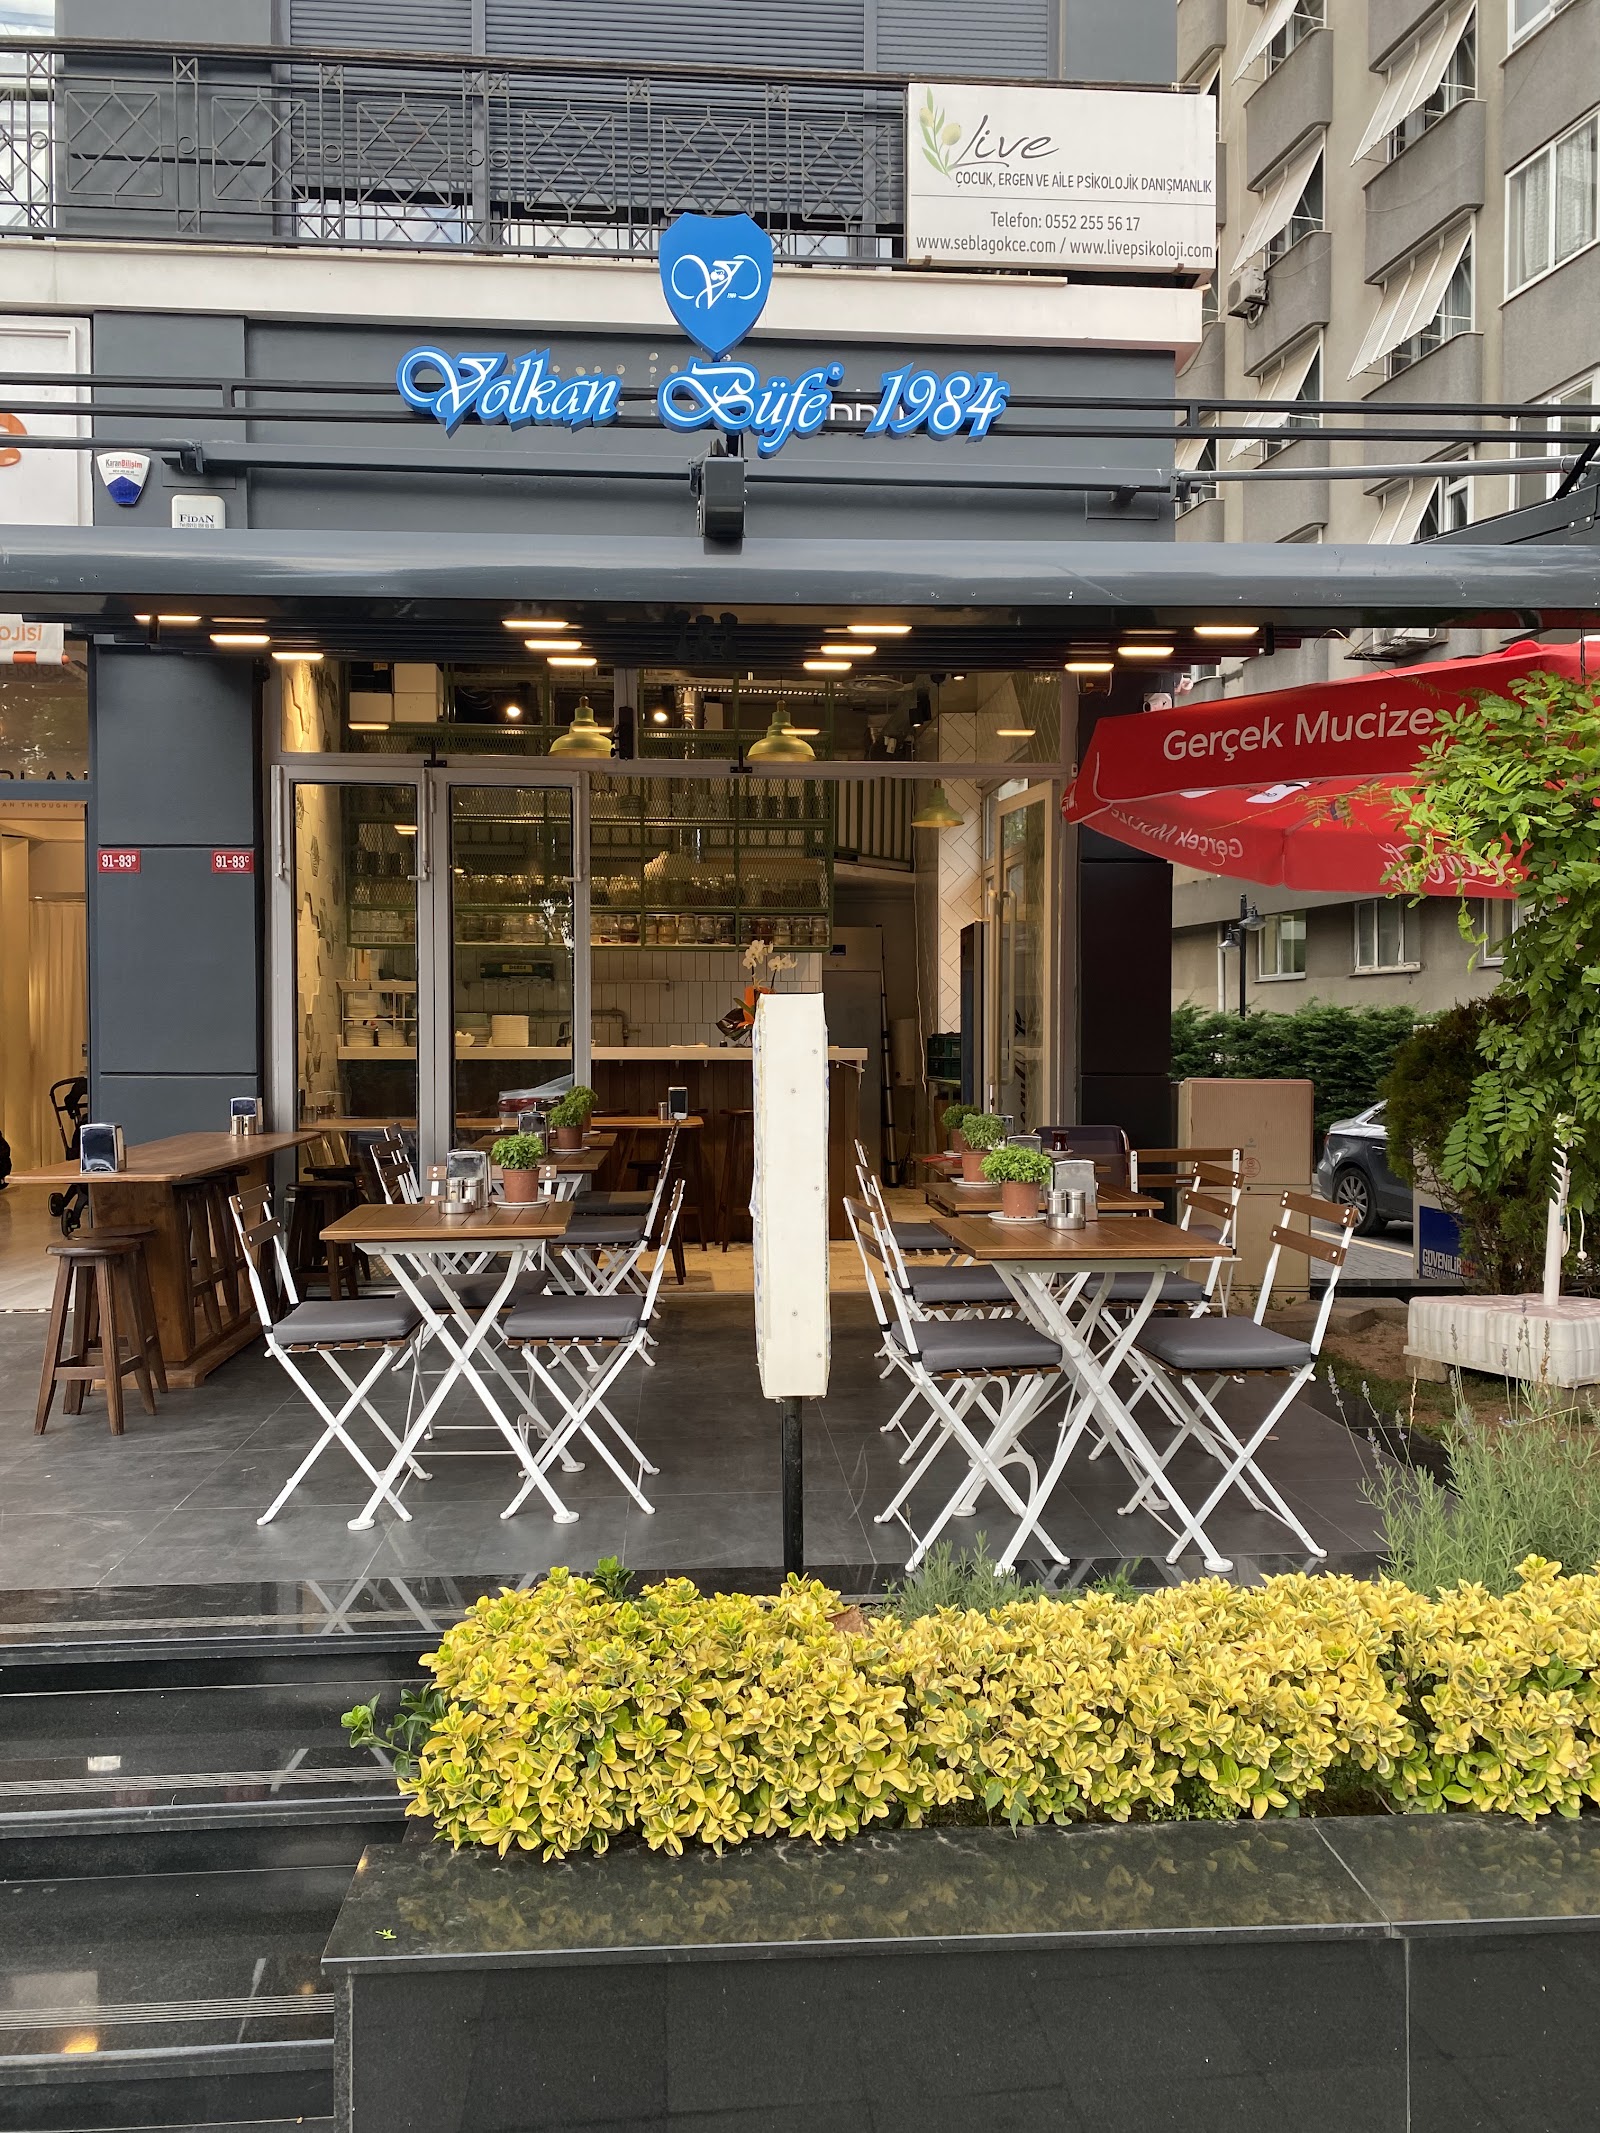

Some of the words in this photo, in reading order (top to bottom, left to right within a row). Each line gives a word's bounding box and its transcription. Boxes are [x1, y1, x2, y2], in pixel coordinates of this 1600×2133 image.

[955, 171, 996, 188] ÇOCUK,
[998, 172, 1034, 187] ERGEN
[1035, 173, 1049, 187] VE
[1051, 171, 1074, 188] AİLE
[1076, 172, 1139, 190] PSİKOLOJİK
[1141, 177, 1212, 195] DANIŞMANLIK
[990, 211, 1042, 228] Telefon:
[1045, 213, 1077, 230] 0552
[1080, 215, 1104, 230] 255
[1107, 216, 1123, 231] 56
[1126, 216, 1141, 231] 17
[916, 234, 1056, 257] www.seblagokce.com
[1069, 238, 1213, 261] www.livepsikoloji.com
[399, 348, 620, 427] Volkan
[869, 367, 1006, 434] 1984
[1163, 715, 1285, 762] Gerçek
[1294, 702, 1434, 746] Mucize
